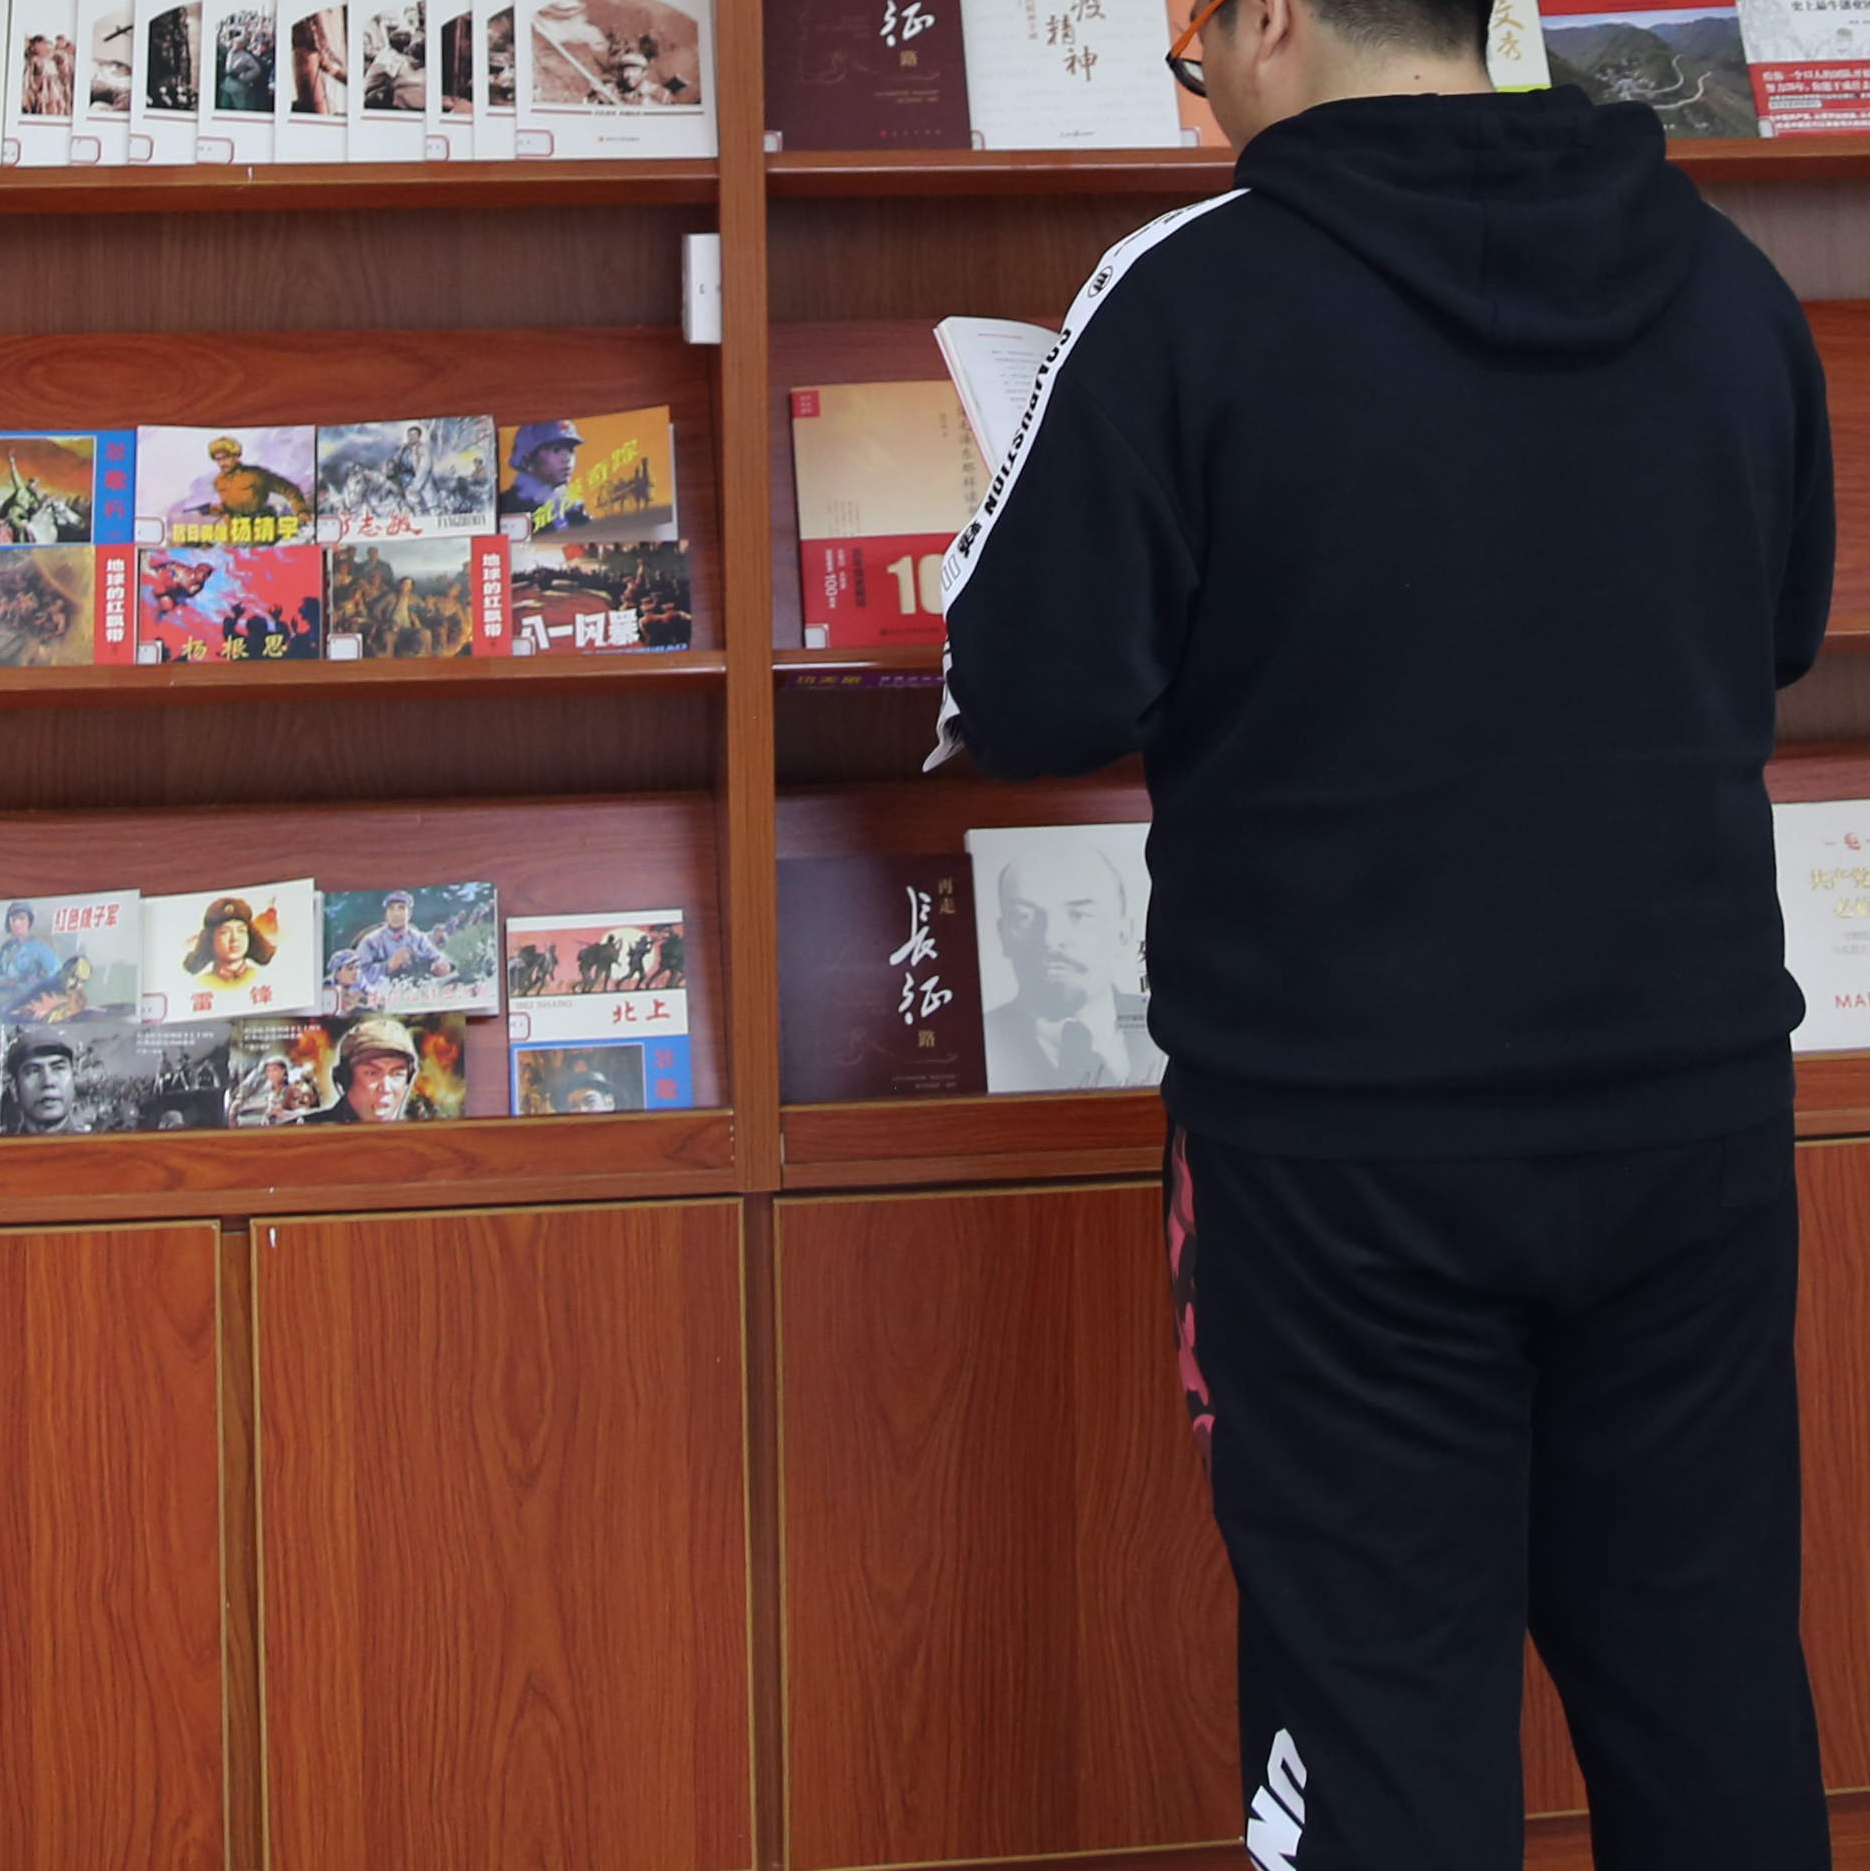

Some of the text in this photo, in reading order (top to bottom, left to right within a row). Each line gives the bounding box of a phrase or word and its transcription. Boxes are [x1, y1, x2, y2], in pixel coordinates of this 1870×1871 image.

[103, 557, 126, 644] 地球的红飘带
[481, 552, 503, 639] 地球的红飘带
[521, 608, 641, 649] 八一风暴
[182, 633, 288, 660] 杨根思
[190, 985, 274, 1013] 雷锋
[611, 998, 672, 1025] 北上
